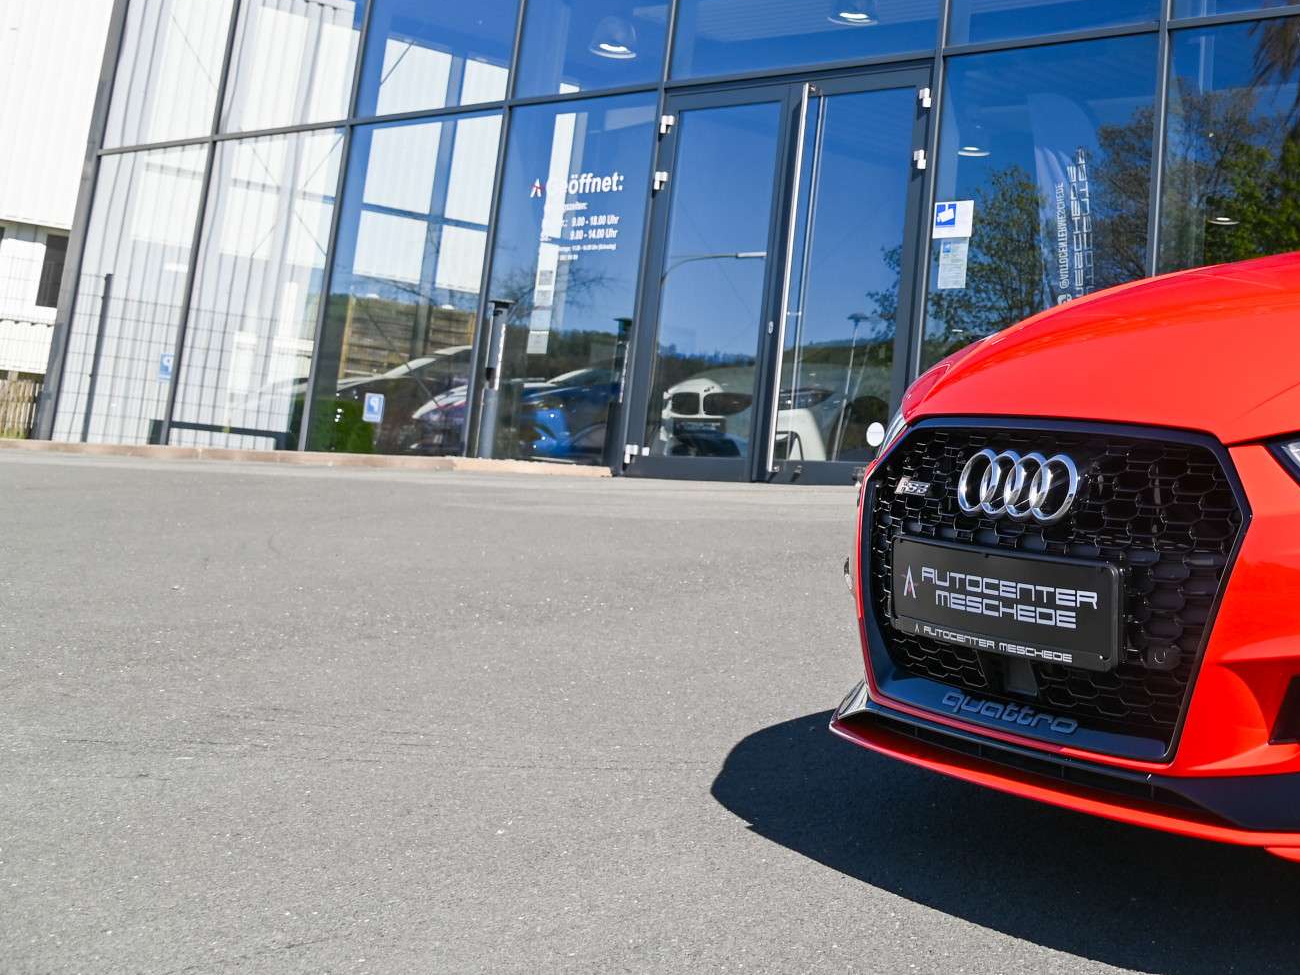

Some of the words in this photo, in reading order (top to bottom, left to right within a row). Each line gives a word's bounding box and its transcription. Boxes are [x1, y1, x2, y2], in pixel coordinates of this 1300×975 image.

[921, 566, 1098, 610] AUTOCENTER
[935, 589, 1077, 629] MESCHEDE
[923, 625, 996, 650] AUTOCENTER
[999, 642, 1073, 663] MESCHEDE
[941, 690, 1079, 734] quattro
